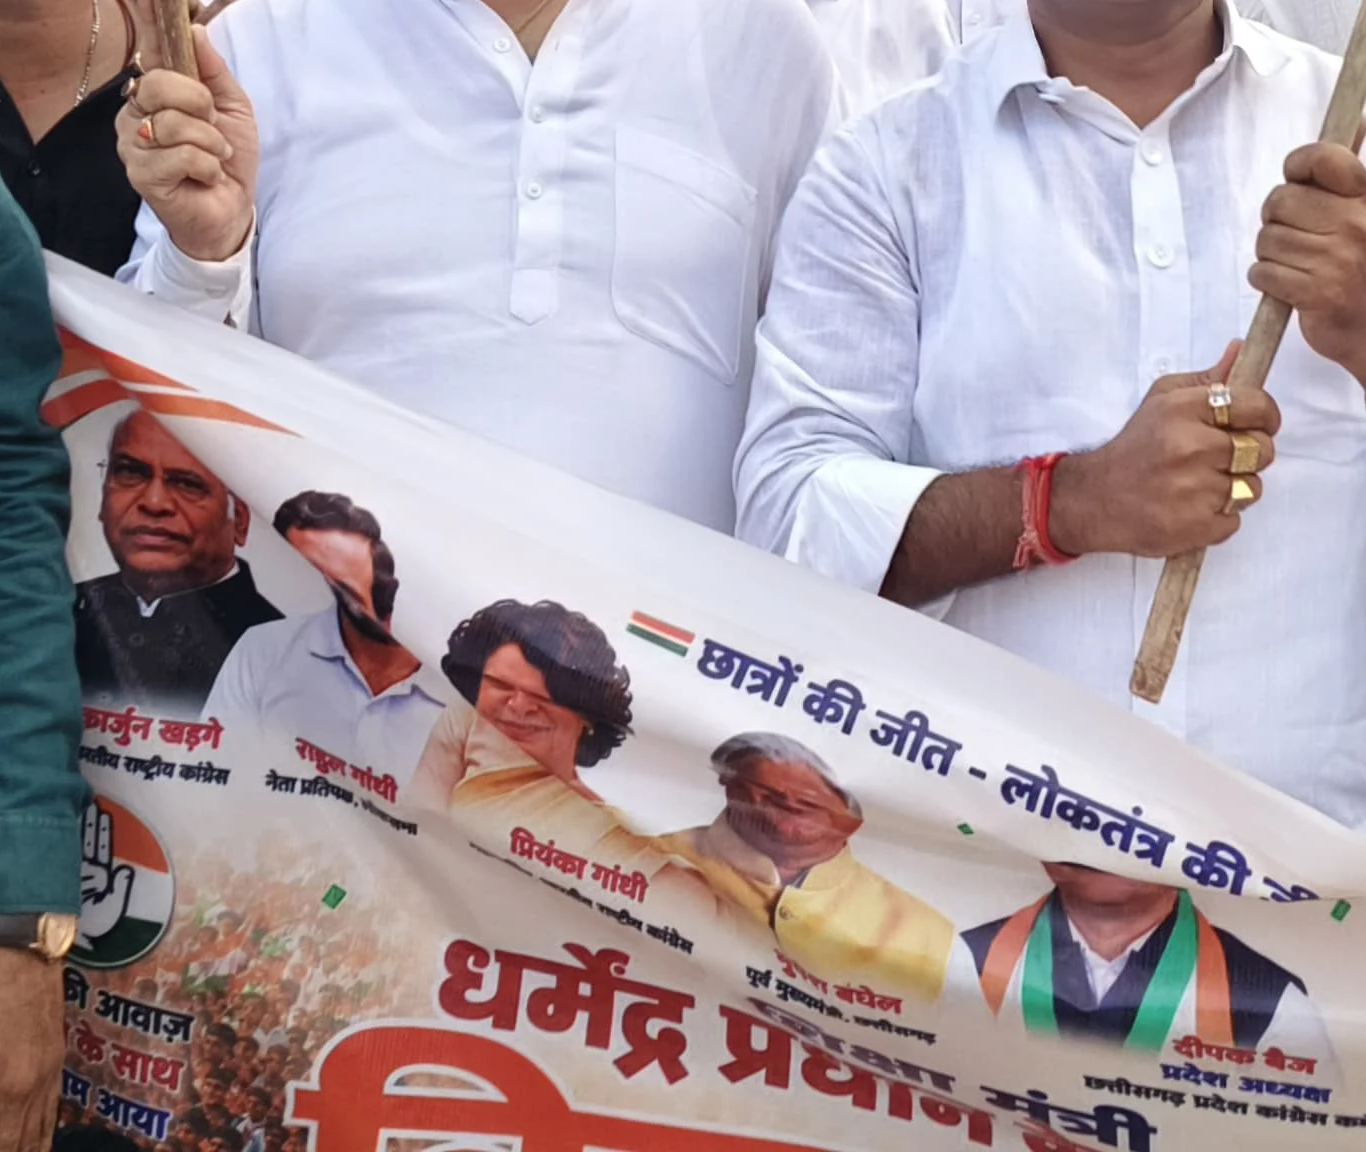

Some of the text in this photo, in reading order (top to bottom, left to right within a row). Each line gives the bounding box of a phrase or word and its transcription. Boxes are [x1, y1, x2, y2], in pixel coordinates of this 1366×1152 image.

[264, 769, 297, 795] नेता
[697, 636, 804, 708] छात्रों
[802, 679, 864, 736] की
[870, 708, 962, 778] जीत
[1001, 763, 1175, 868] लोकतंत्र
[1181, 840, 1252, 896] की
[510, 826, 588, 881] प्रियंका
[591, 864, 649, 904] गांधी
[438, 939, 696, 1086] धर्मेंद्र
[74, 1019, 106, 1063] के
[111, 1043, 184, 1091] साथ
[1160, 1062, 1231, 1089] प्रदेश
[95, 1088, 171, 1140] आया
